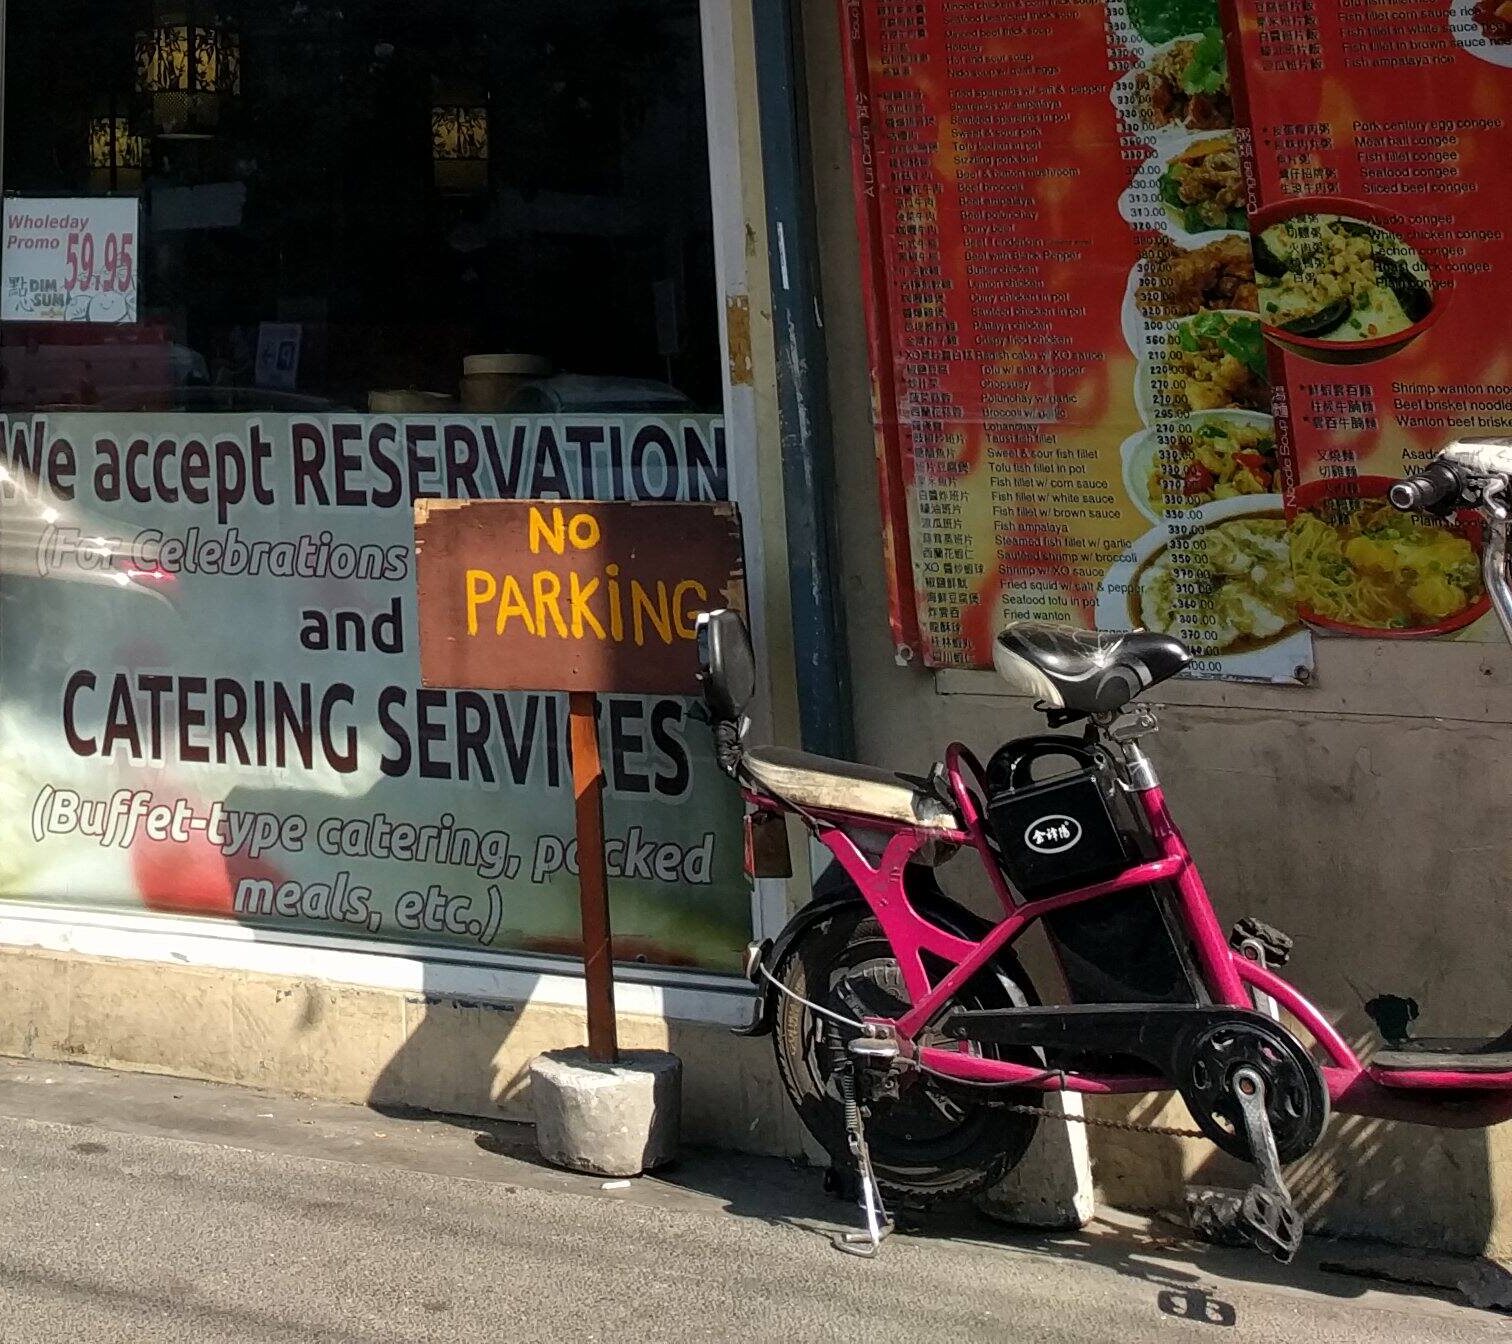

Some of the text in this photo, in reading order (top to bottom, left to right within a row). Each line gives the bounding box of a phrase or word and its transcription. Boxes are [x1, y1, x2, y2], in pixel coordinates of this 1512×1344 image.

[7, 213, 90, 233] Wholeday
[7, 231, 134, 293] Promo 59.95
[29, 278, 58, 293] DIM
[33, 292, 65, 308] SUM
[1391, 382, 1484, 394] Shrimp wanton
[92, 422, 275, 524] accept
[292, 423, 728, 510] RESERVATION
[992, 505, 1121, 519] Fish fillet w/ brown sauce
[130, 528, 409, 582] Celebrations
[1002, 593, 1100, 608] Seafood tofu in pot
[1003, 608, 1071, 621] Fried wanton
[299, 597, 403, 655] and
[1181, 629, 1219, 641] 370.00
[61, 669, 690, 797] CATERING SERVIES
[30, 784, 306, 855] (Buffet-type
[317, 812, 523, 878] catering,
[233, 871, 505, 946] meals, etc.)
